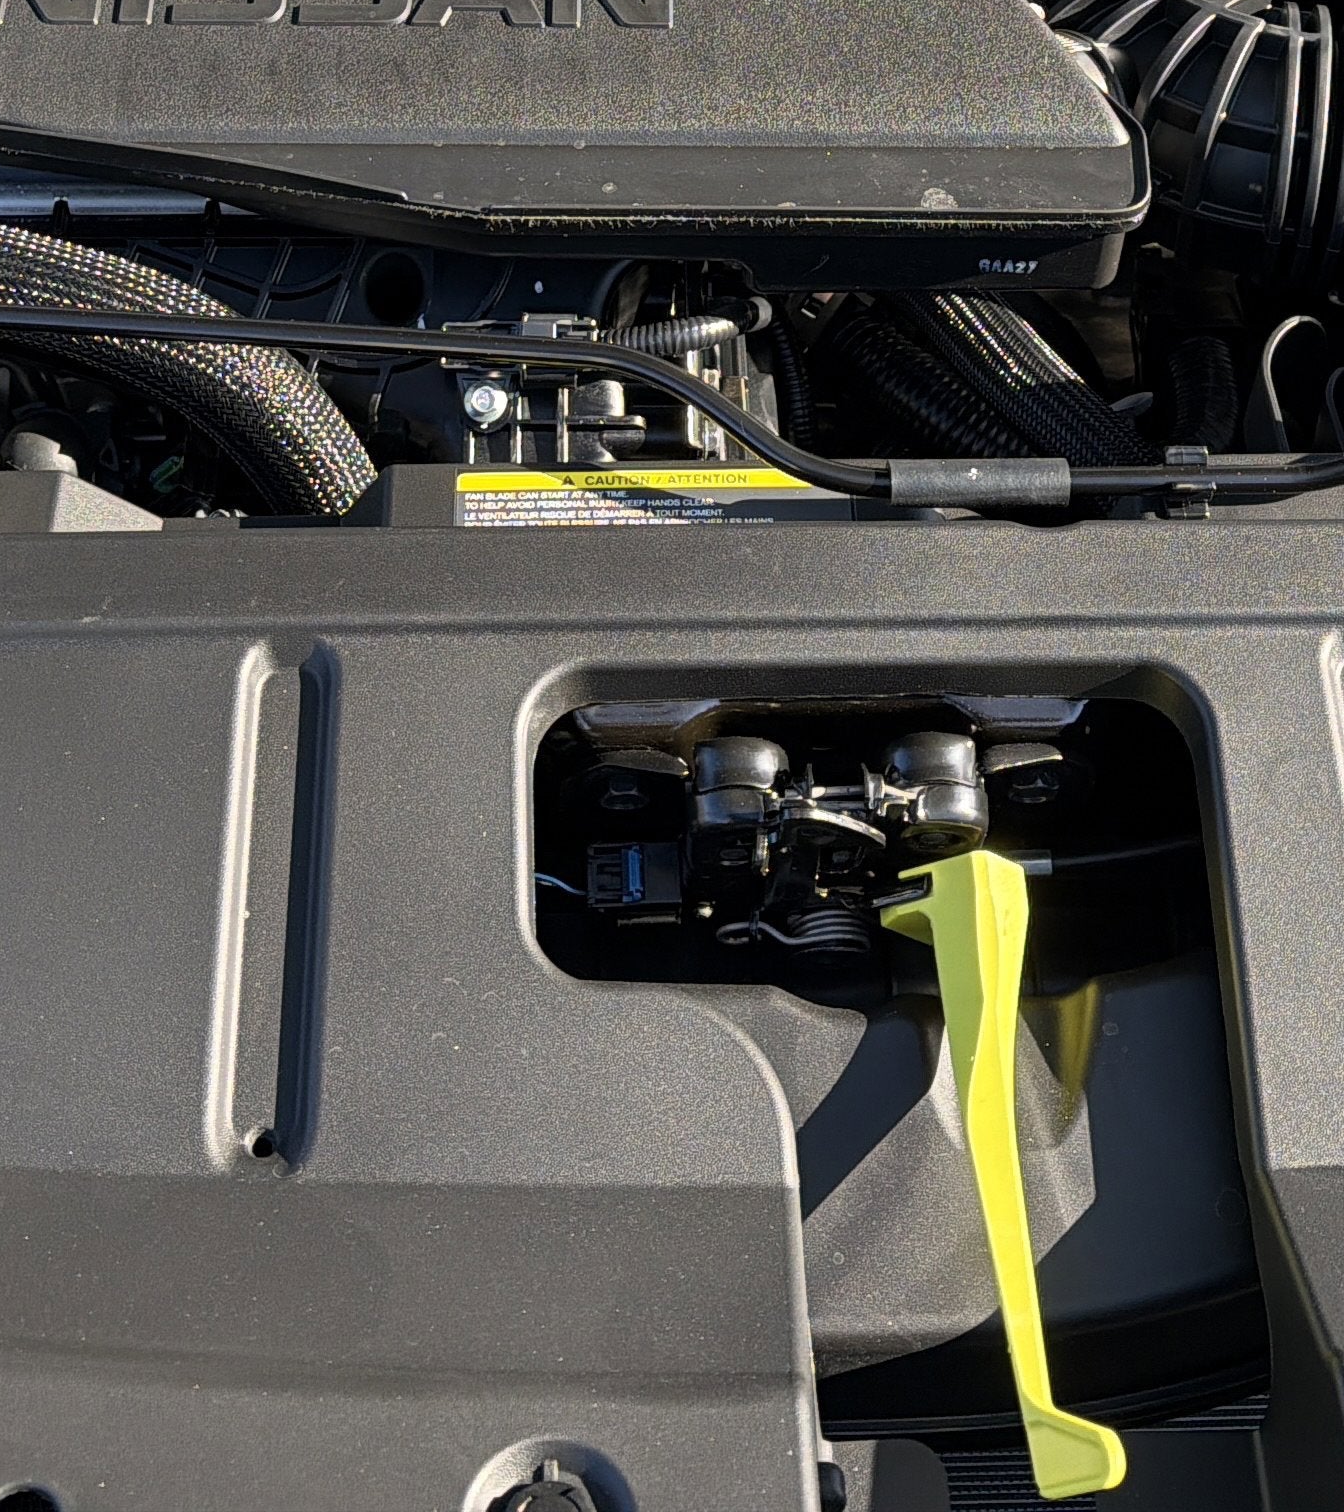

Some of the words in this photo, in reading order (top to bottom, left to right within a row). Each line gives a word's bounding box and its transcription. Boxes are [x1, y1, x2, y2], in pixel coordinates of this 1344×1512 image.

[584, 475, 650, 486] CAUTION
[667, 473, 747, 485] ATTENTION
[464, 492, 484, 501] FAN
[485, 491, 517, 500] BLADE
[517, 491, 539, 500] CAN
[540, 491, 569, 499] START
[570, 490, 583, 499] AT
[584, 490, 603, 498] ANY
[464, 501, 479, 510] TO
[479, 501, 505, 510] HELP
[506, 500, 536, 509] AVOID
[536, 500, 587, 509] PERSONAL
[647, 498, 680, 507] HANDS
[464, 512, 477, 521] LE
[477, 511, 540, 521] VENTILATEUR
[540, 510, 577, 520] RISQUE
[577, 510, 592, 519] DE
[655, 509, 679, 518] TOUT
[681, 508, 725, 517] MOMENT.
